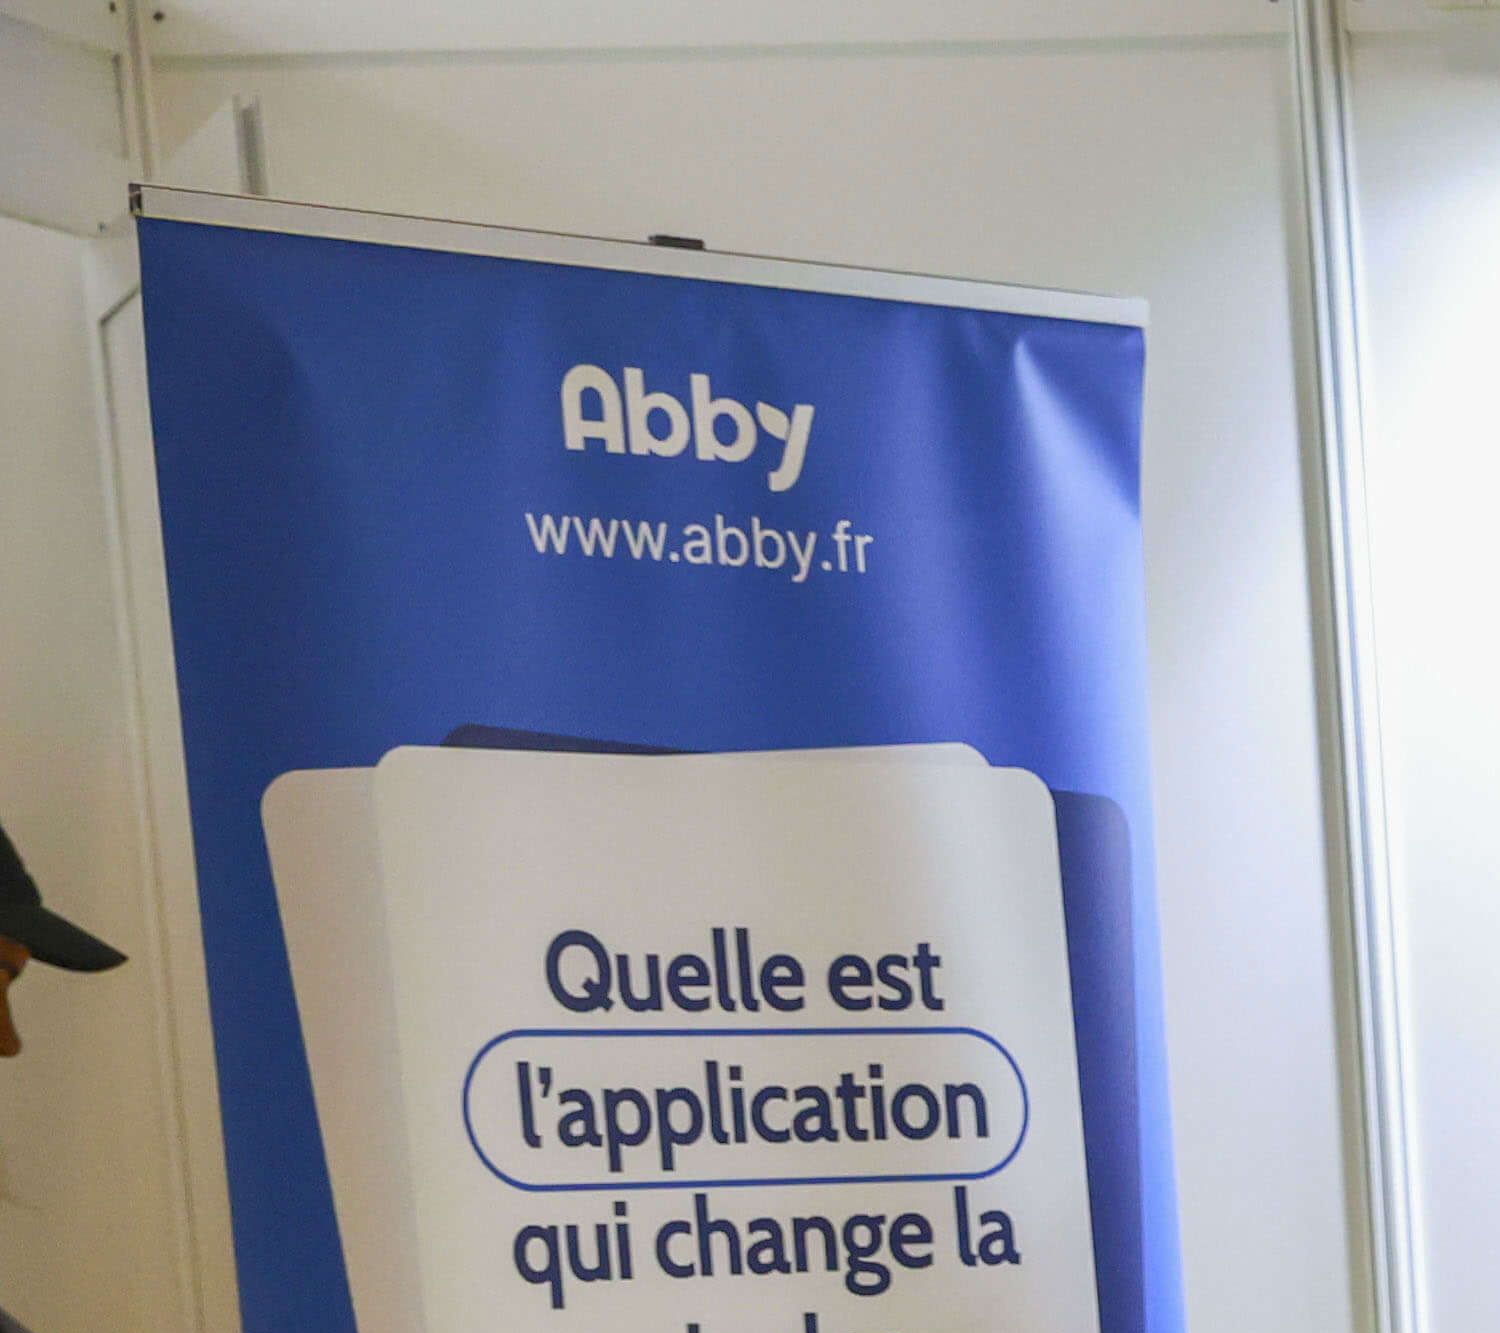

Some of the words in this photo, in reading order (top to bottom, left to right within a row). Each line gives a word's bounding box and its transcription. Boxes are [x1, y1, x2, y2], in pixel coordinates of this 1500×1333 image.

[560, 363, 816, 493] Abby
[525, 511, 876, 583] www.abby.fr
[545, 927, 806, 1013] Quelle
[827, 942, 944, 1011] est
[516, 1060, 990, 1174] l’application
[513, 1201, 633, 1309] qui
[655, 1193, 933, 1296] change
[954, 1186, 1021, 1267] la
